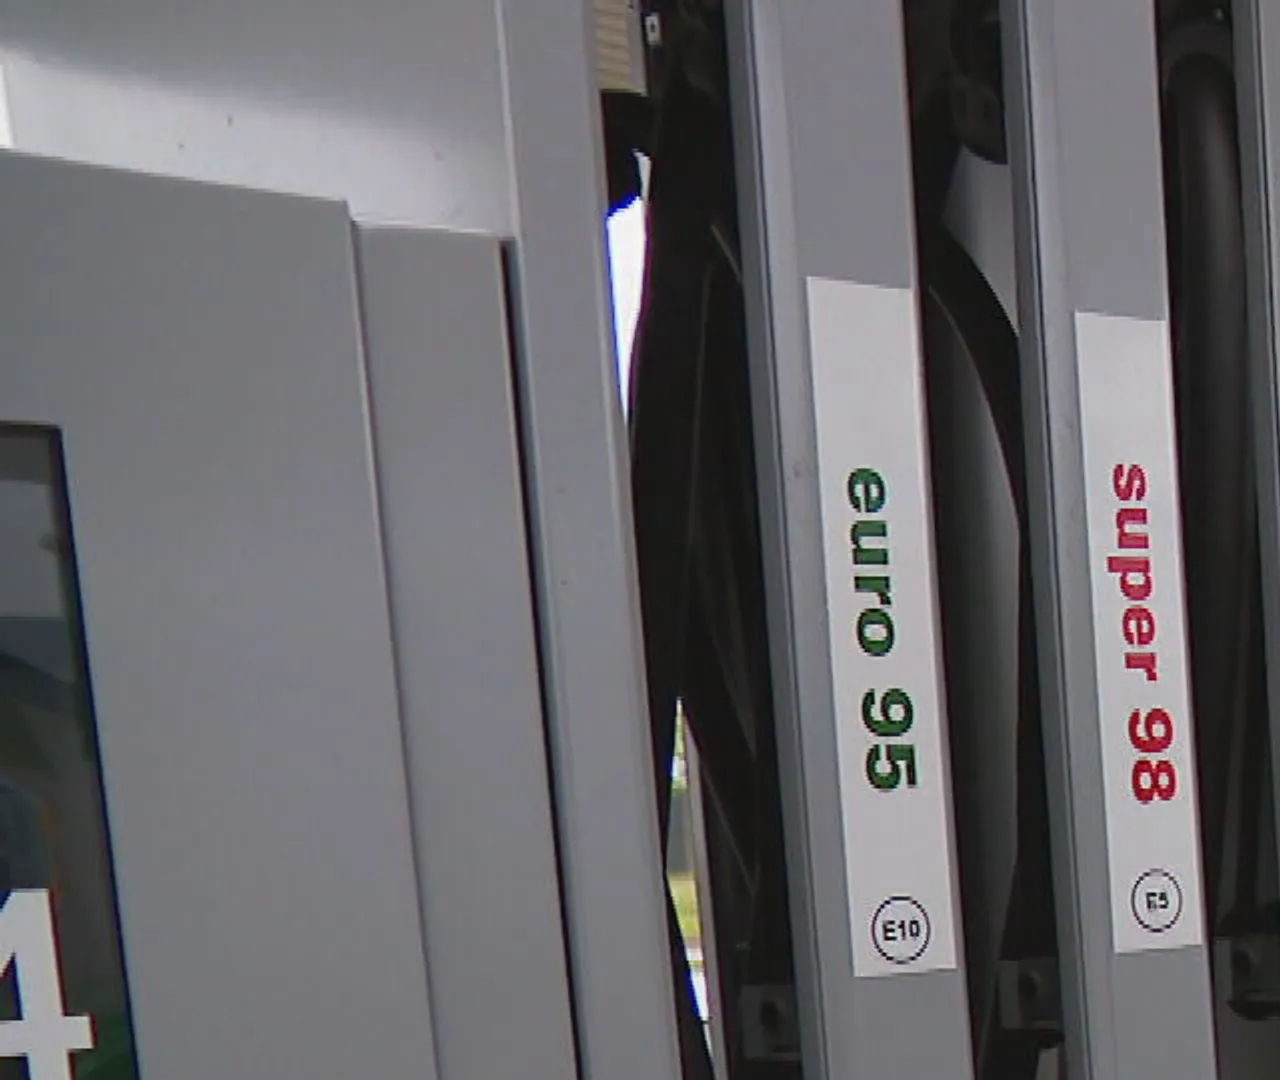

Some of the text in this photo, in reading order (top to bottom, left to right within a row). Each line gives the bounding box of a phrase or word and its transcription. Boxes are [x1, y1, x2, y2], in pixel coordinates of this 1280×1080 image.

[847, 467, 918, 792] euro 95
[1107, 464, 1176, 804] super 98
[882, 919, 921, 942] E10
[1146, 890, 1169, 911] E5
